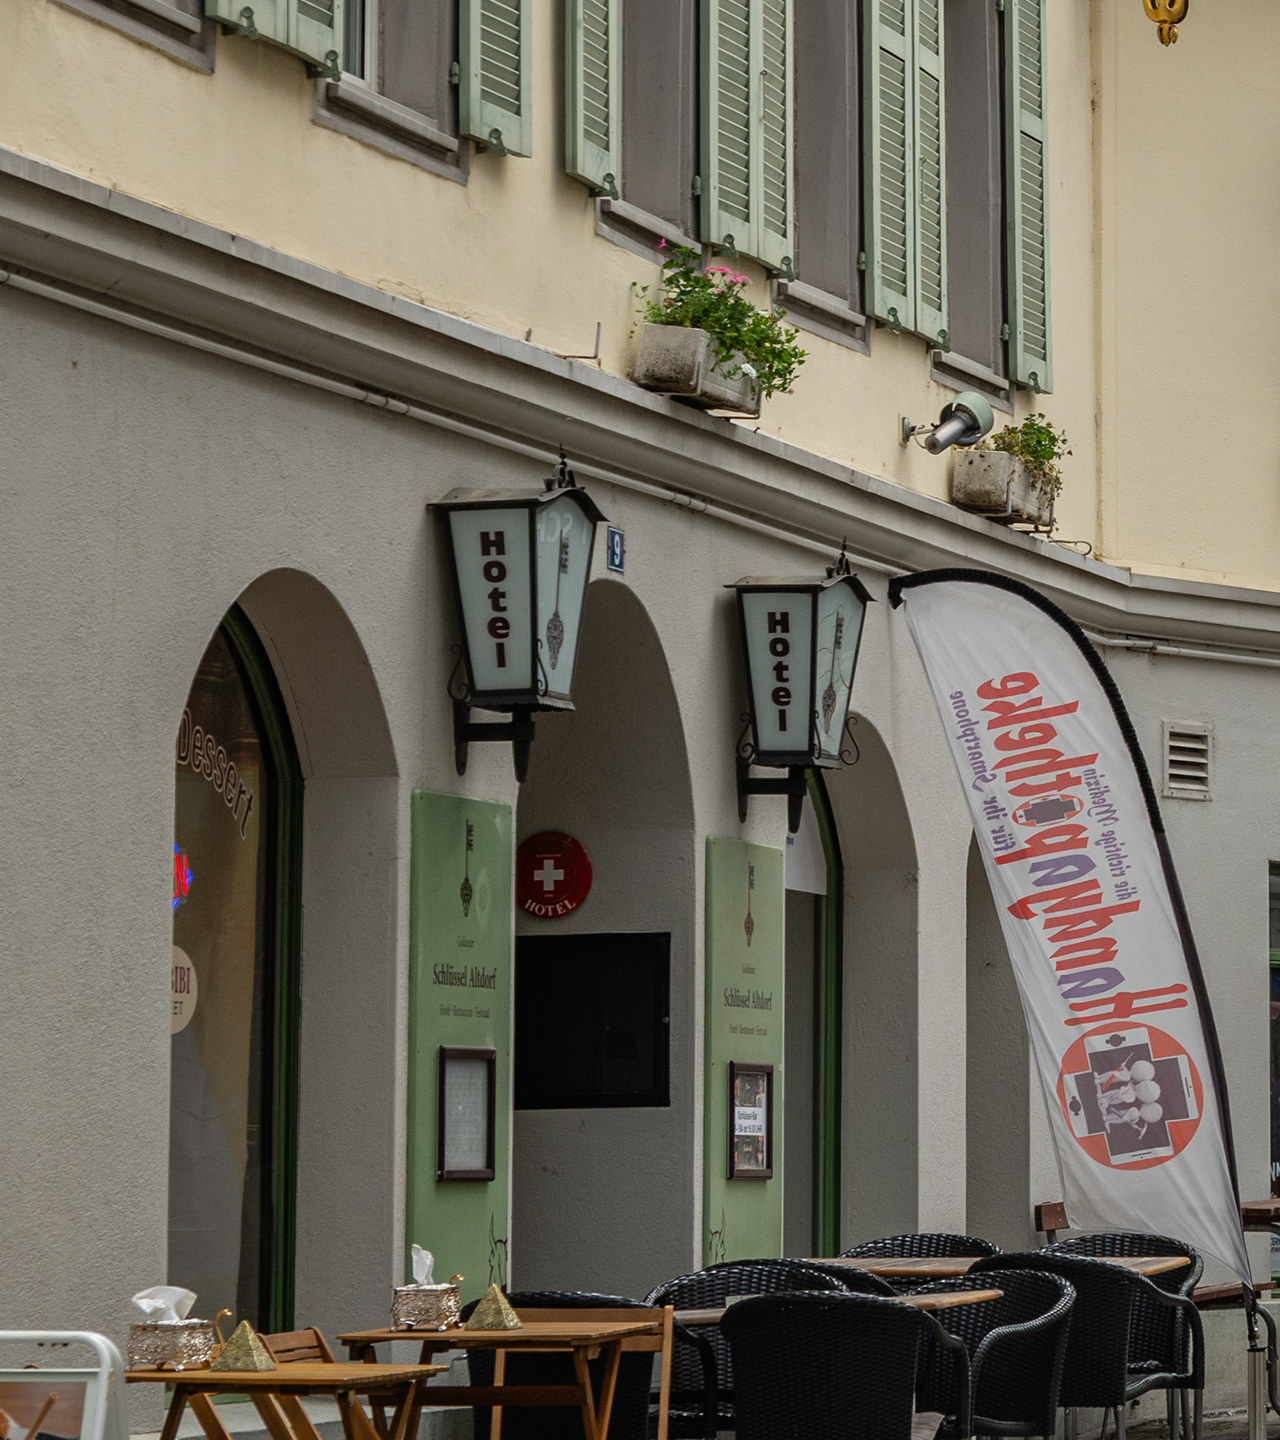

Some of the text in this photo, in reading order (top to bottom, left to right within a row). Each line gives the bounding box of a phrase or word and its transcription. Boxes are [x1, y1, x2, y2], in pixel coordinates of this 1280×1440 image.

[614, 534, 621, 566] 9
[479, 531, 511, 668] Hotel
[767, 611, 792, 732] Hotel
[177, 706, 254, 841] Dessert
[524, 898, 577, 917] HOTEL
[432, 963, 497, 990] Schlüssel Altdorf
[724, 987, 773, 1011] Schlüssel Altdorf
